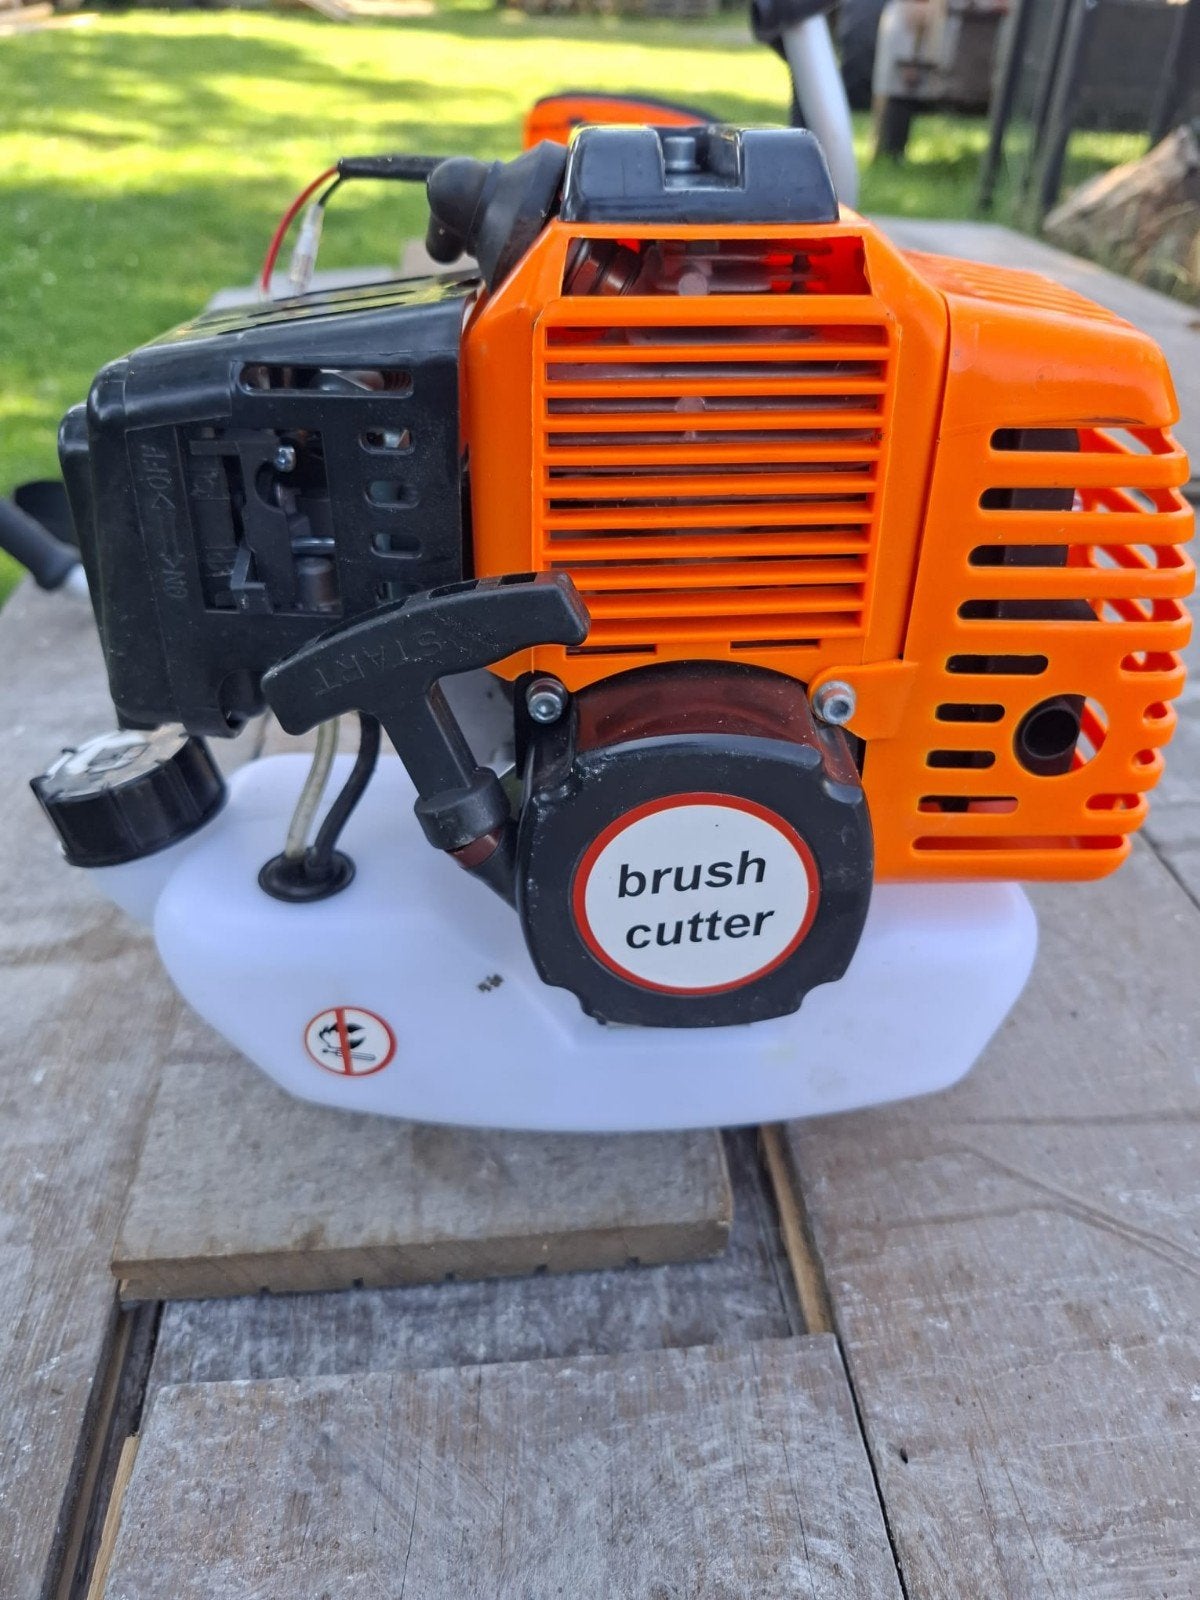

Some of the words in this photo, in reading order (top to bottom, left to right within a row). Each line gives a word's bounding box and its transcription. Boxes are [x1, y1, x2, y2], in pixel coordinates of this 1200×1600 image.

[139, 443, 172, 490] OFF
[160, 569, 188, 599] ON
[313, 630, 443, 697] START
[617, 849, 767, 899] brush
[625, 909, 776, 950] cutter
